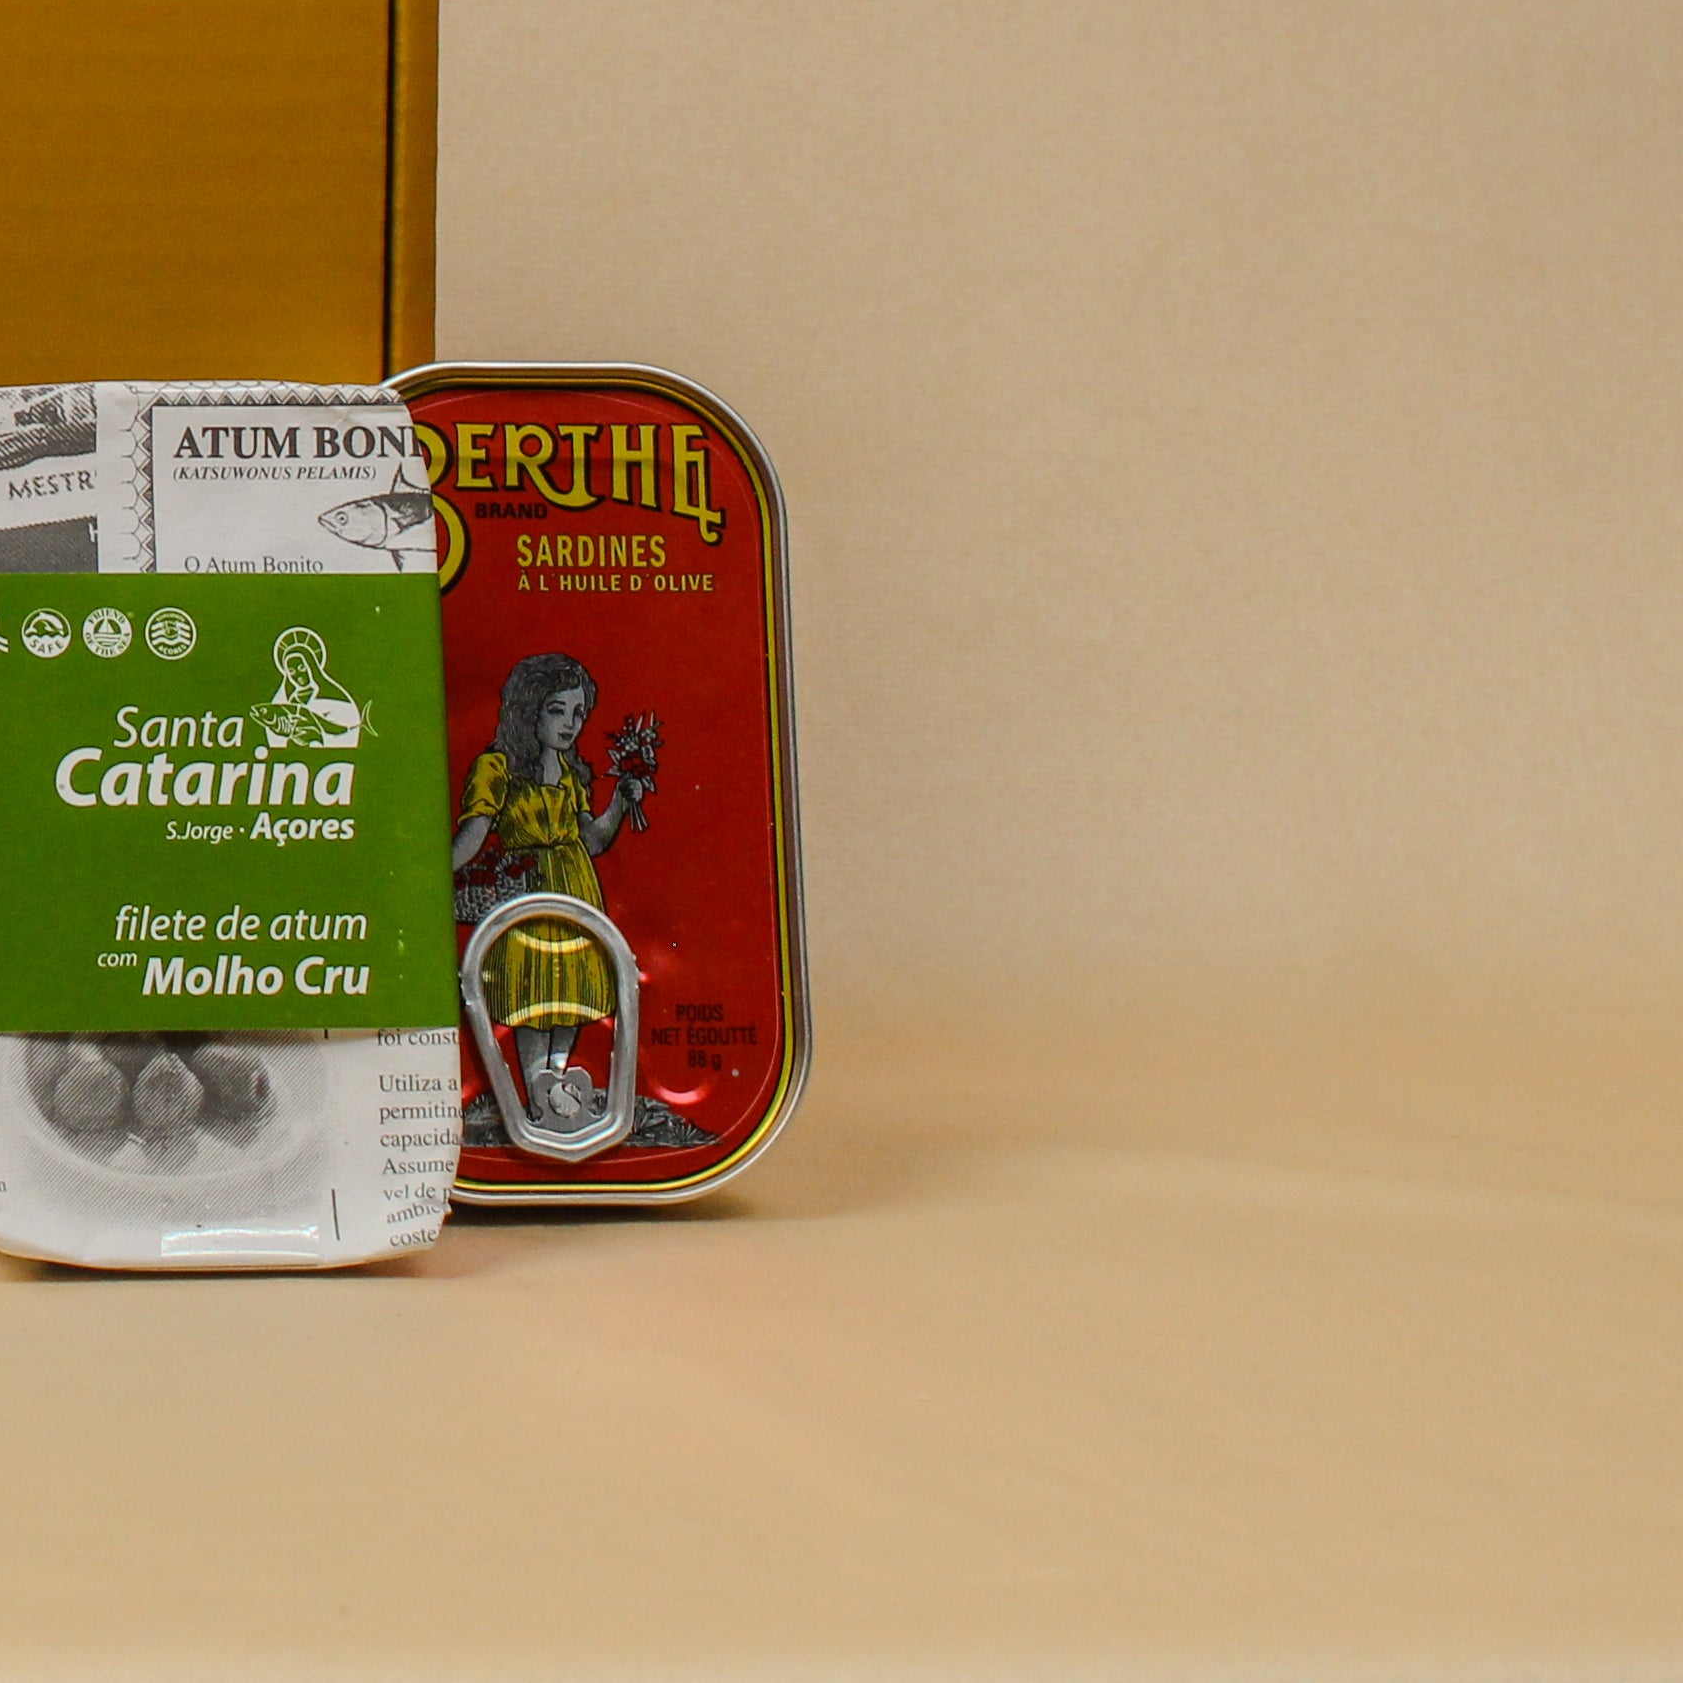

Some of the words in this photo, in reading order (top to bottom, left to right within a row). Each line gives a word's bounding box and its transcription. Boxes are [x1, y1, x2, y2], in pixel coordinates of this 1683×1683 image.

[173, 426, 300, 459] ATUM
[173, 466, 291, 481] (KATSUWONUS
[296, 466, 377, 481] PELAMIS)
[8, 470, 97, 501] MESTR
[475, 502, 548, 519] BRAND
[516, 534, 666, 568] SARDINES
[184, 556, 200, 573] O
[206, 556, 256, 573] Atum
[262, 555, 324, 573] Bonito
[518, 570, 531, 591] À
[88, 607, 126, 625] FRIEND
[30, 639, 65, 655] SAFE
[113, 705, 245, 748] Santa
[55, 745, 356, 807] Catarina
[166, 821, 234, 844] S.Jorge
[249, 811, 356, 847] Açores
[115, 904, 207, 941] filete
[215, 904, 261, 941] de
[269, 908, 368, 940] atum
[96, 951, 138, 968] com
[142, 955, 285, 996] Molho
[294, 956, 371, 996] Cru
[676, 1004, 724, 1021] POIDS
[651, 1027, 681, 1045] NET
[379, 1074, 442, 1092] Utiliza
[382, 1158, 455, 1175] Assume
[415, 1182, 436, 1199] de
